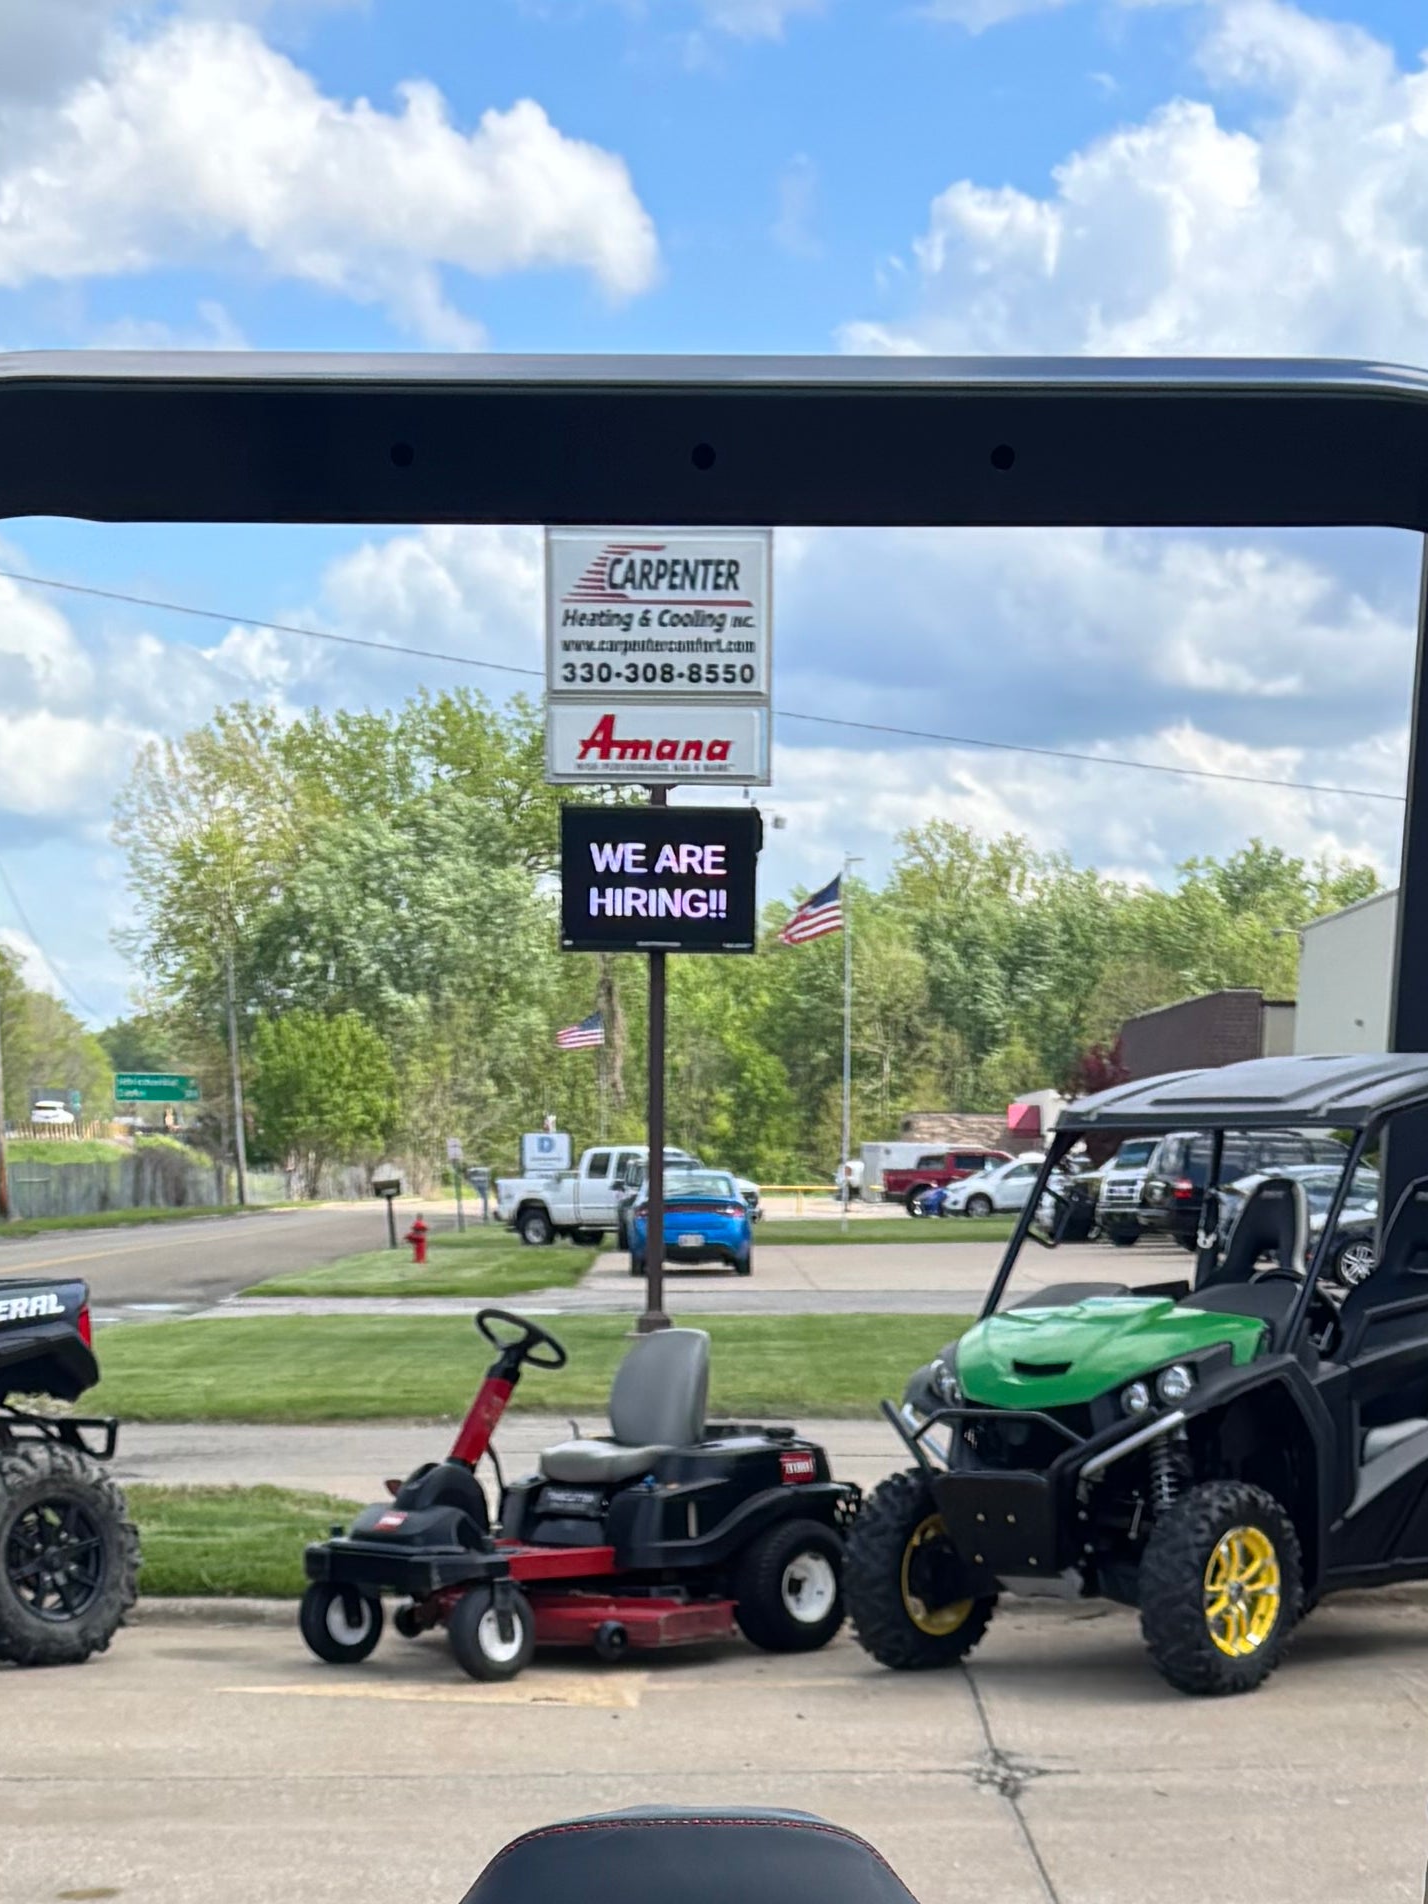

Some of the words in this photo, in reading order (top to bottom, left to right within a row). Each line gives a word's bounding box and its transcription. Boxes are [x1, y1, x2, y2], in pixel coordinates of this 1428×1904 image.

[608, 558, 740, 590] CARPENTER
[561, 609, 634, 632] Heating
[638, 609, 652, 628] &
[657, 609, 727, 633] Cooling
[576, 713, 733, 761] Amana
[589, 842, 648, 873] WE
[654, 844, 727, 875] ARE
[589, 887, 727, 919] HIRING!!
